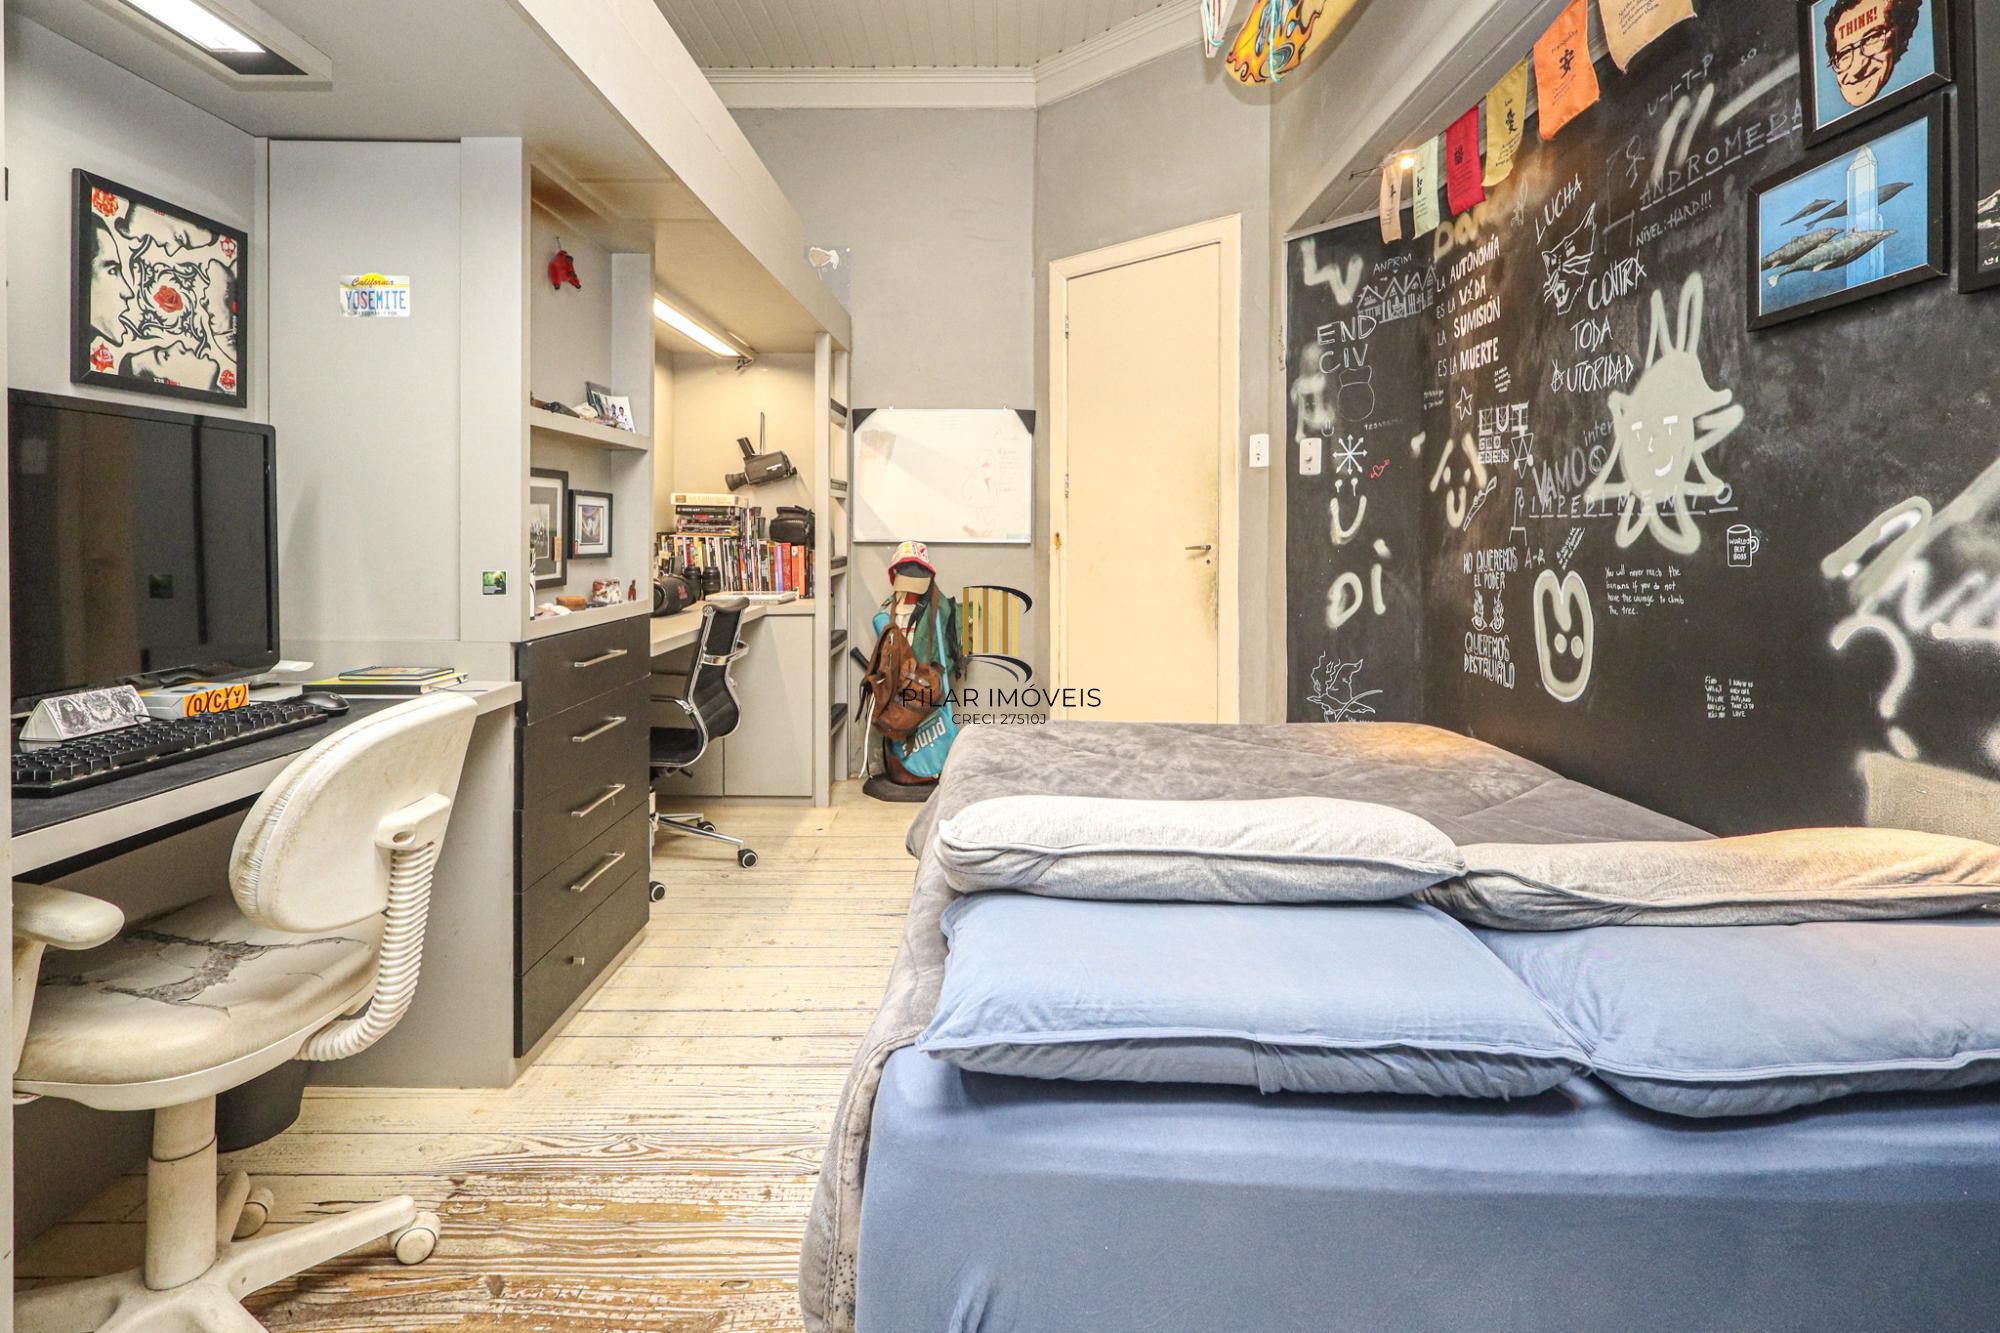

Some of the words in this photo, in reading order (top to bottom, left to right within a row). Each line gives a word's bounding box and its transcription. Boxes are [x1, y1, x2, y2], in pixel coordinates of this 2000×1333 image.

[1838, 5, 1878, 40] THINK!
[1639, 103, 1803, 206] ANDROMEDA
[1534, 172, 1583, 247] LUCHA
[1436, 275, 1447, 293] LA
[1450, 233, 1500, 285] AUTONOMÍA
[351, 276, 395, 287] California
[1587, 250, 1648, 311] CONTRA
[345, 290, 407, 310] YOSEMITE
[1436, 304, 1446, 320] ES
[1447, 297, 1456, 314] LA
[1317, 314, 1377, 345] END
[1437, 329, 1447, 347] LA
[1453, 295, 1501, 339] SUMISIÓN
[1570, 316, 1613, 352] TODA
[1319, 344, 1370, 375] CIV
[1437, 358, 1448, 377] ES
[1449, 355, 1458, 375] LA
[1459, 337, 1499, 373] MUERTE
[1550, 355, 1635, 393] AUTORIDAD
[1463, 552, 1473, 575] NO
[1476, 546, 1519, 573] QUEREMOS
[1733, 545, 1746, 553] BEST
[1733, 552, 1747, 561] BOSS
[1473, 574, 1482, 587] EL
[1484, 571, 1506, 590] PODER
[1605, 566, 1614, 579] You
[1616, 563, 1625, 576] will
[1668, 565, 1681, 577] the
[1622, 592, 1632, 603] the
[1667, 594, 1685, 605] climb
[1632, 580, 1638, 593] if
[1640, 582, 1651, 594] you
[1653, 581, 1660, 590] do
[1664, 580, 1676, 591] not
[1464, 631, 1511, 662] QUEREMOS
[902, 717, 946, 757] prin
